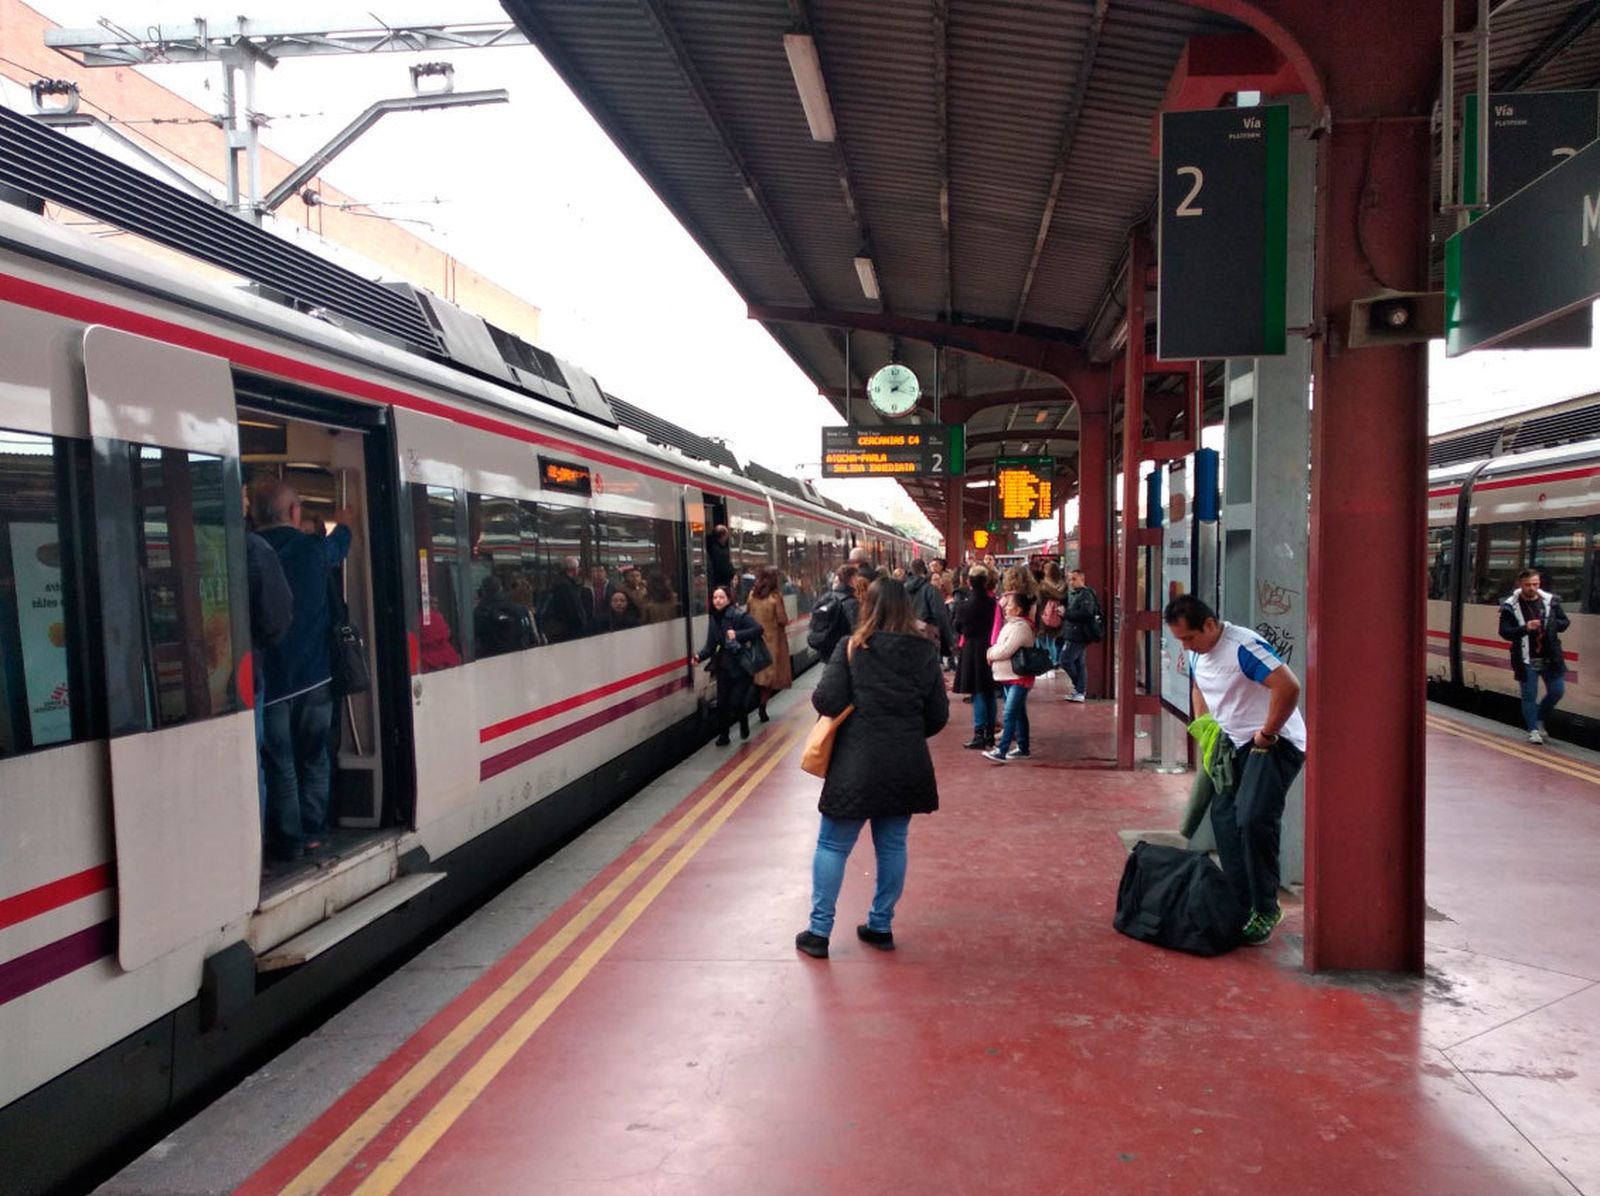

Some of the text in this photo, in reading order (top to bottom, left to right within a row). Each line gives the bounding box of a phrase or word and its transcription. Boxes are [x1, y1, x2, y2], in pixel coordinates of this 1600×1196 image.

[1495, 105, 1514, 117] Vía
[1243, 116, 1262, 129] Vía
[1176, 166, 1203, 217] 2
[908, 435, 920, 446] C4
[931, 453, 943, 473] 2
